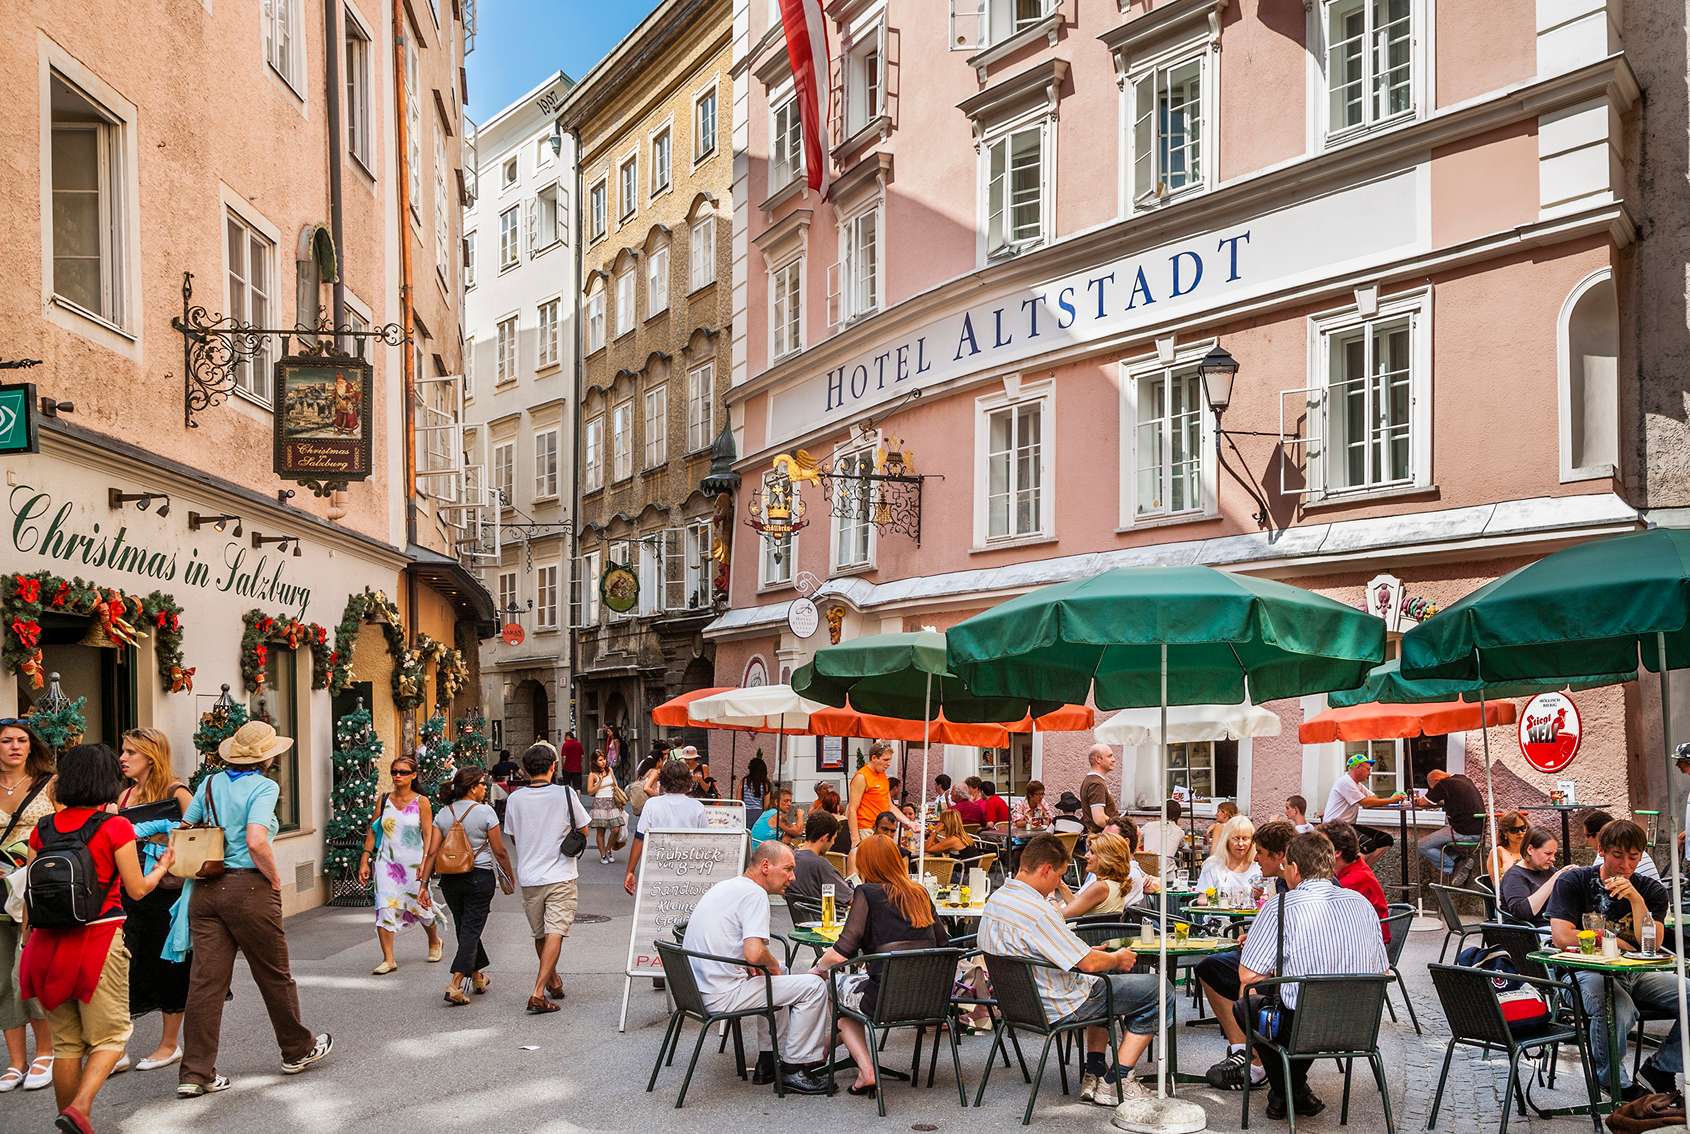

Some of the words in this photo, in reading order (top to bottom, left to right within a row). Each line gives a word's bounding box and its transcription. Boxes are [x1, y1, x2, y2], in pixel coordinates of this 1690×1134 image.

[536, 90, 558, 115] 1997
[825, 336, 931, 413] HOTEL
[953, 230, 1252, 361] ALTSTADT
[297, 443, 350, 455] Christmas
[297, 456, 348, 470] Salzburg
[9, 485, 177, 581] Christmas
[184, 547, 210, 588] in
[216, 541, 312, 622] Salzburg
[1526, 714, 1552, 731] Stiegl
[655, 847, 721, 862] Frühstück
[658, 861, 674, 869] von
[649, 880, 714, 897] Sandwic
